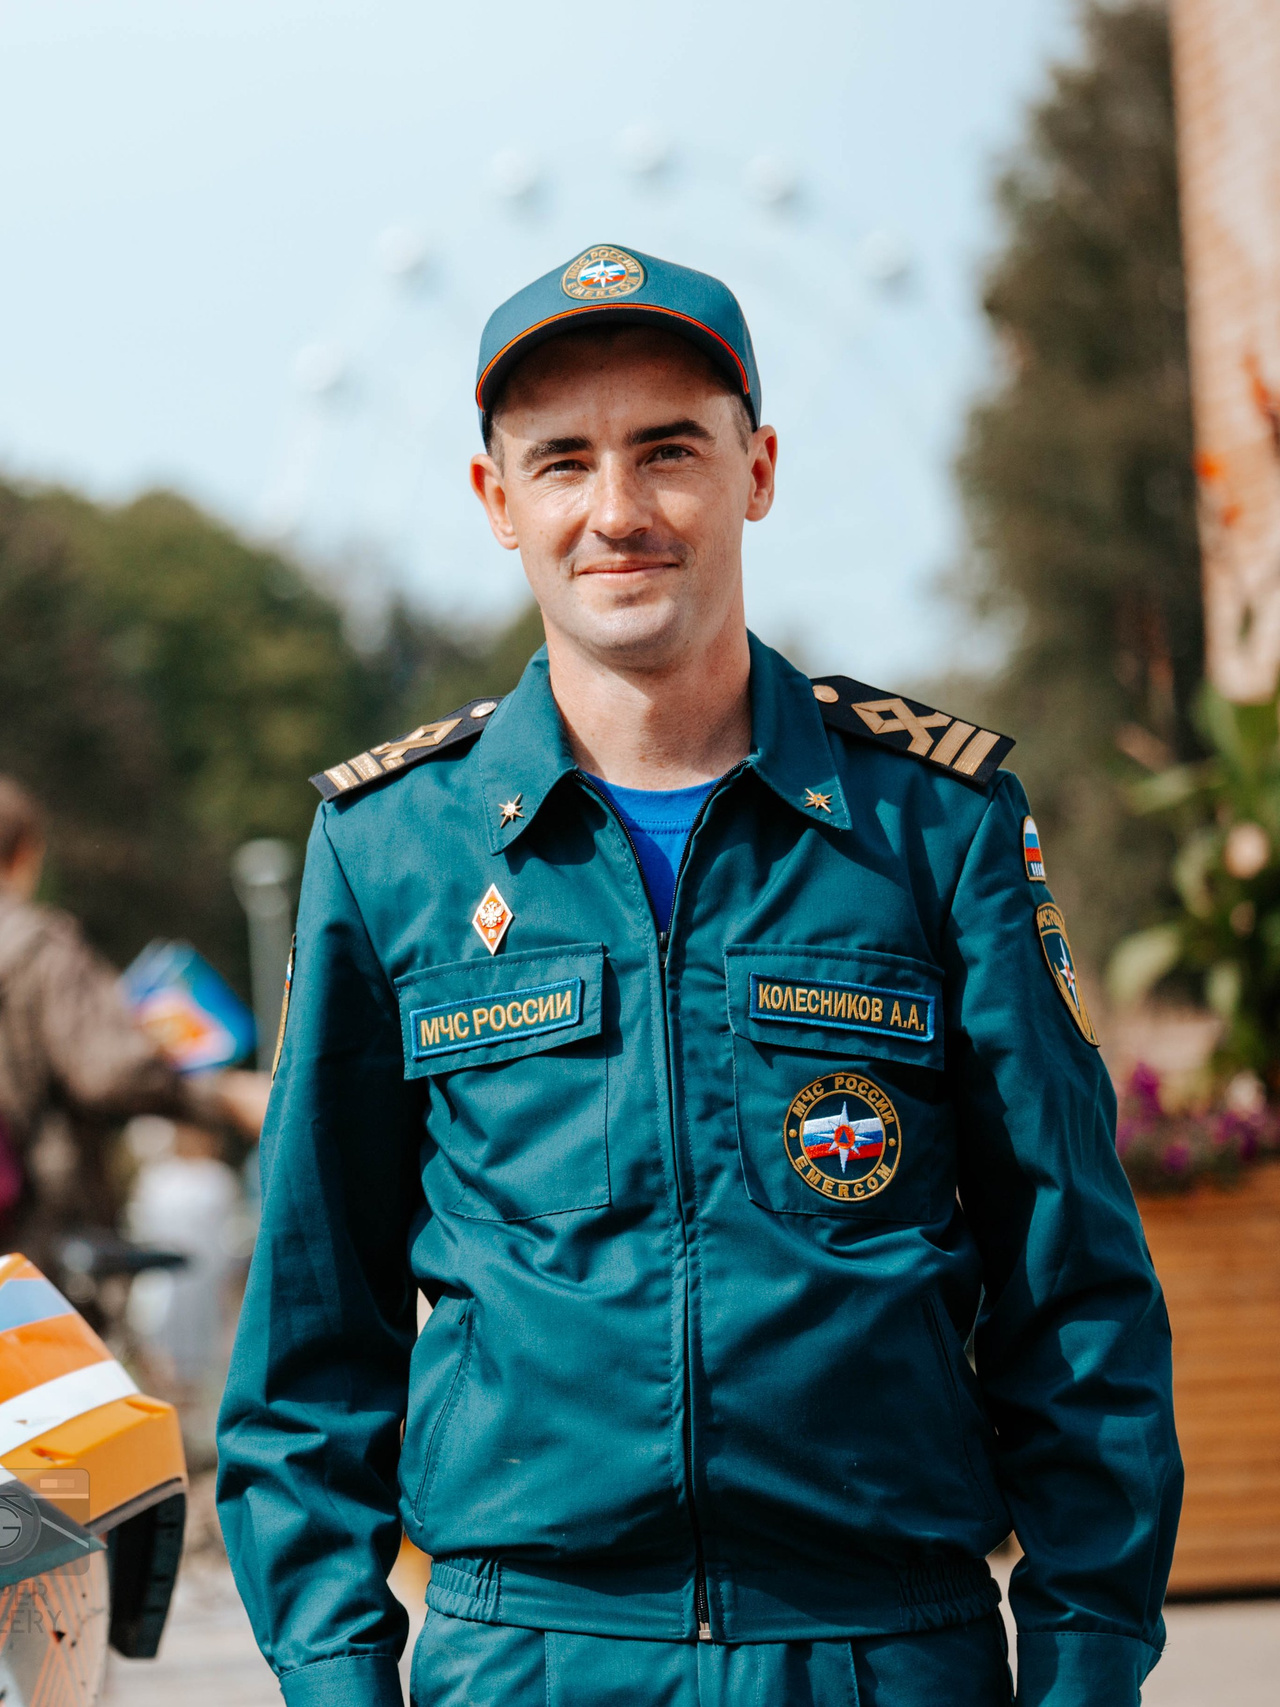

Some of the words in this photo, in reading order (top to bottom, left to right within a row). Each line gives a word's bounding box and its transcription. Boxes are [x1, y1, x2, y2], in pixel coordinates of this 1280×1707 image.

[420, 1011, 470, 1047] МЧС
[472, 990, 572, 1036] РОССИИ
[758, 983, 883, 1023] КОЛЕСНИКОВ
[889, 1000, 925, 1031] А.А.
[792, 1083, 824, 1118] МЧС
[834, 1076, 895, 1125] РОССИИ
[795, 1155, 892, 1198] EMERCOM
